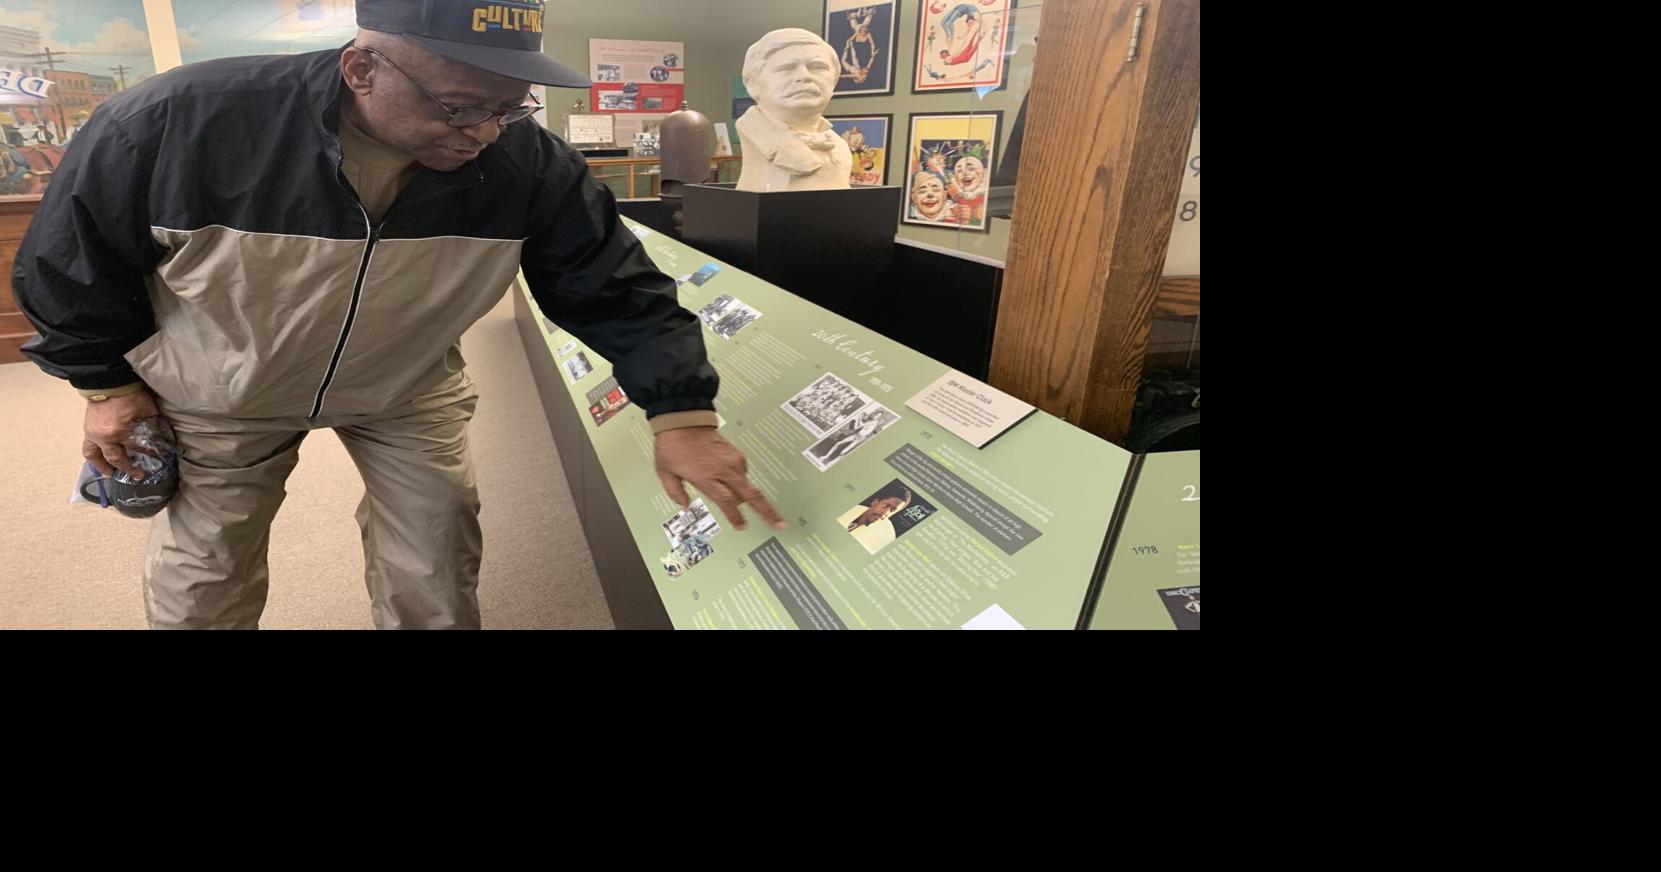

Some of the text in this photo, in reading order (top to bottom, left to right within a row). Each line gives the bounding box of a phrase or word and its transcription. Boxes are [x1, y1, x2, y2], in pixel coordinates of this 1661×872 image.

[1179, 200, 1198, 222] 8
[835, 339, 886, 376] Century
[974, 393, 993, 405] Clock
[1181, 484, 1200, 502] 2
[1132, 545, 1159, 556] 1978
